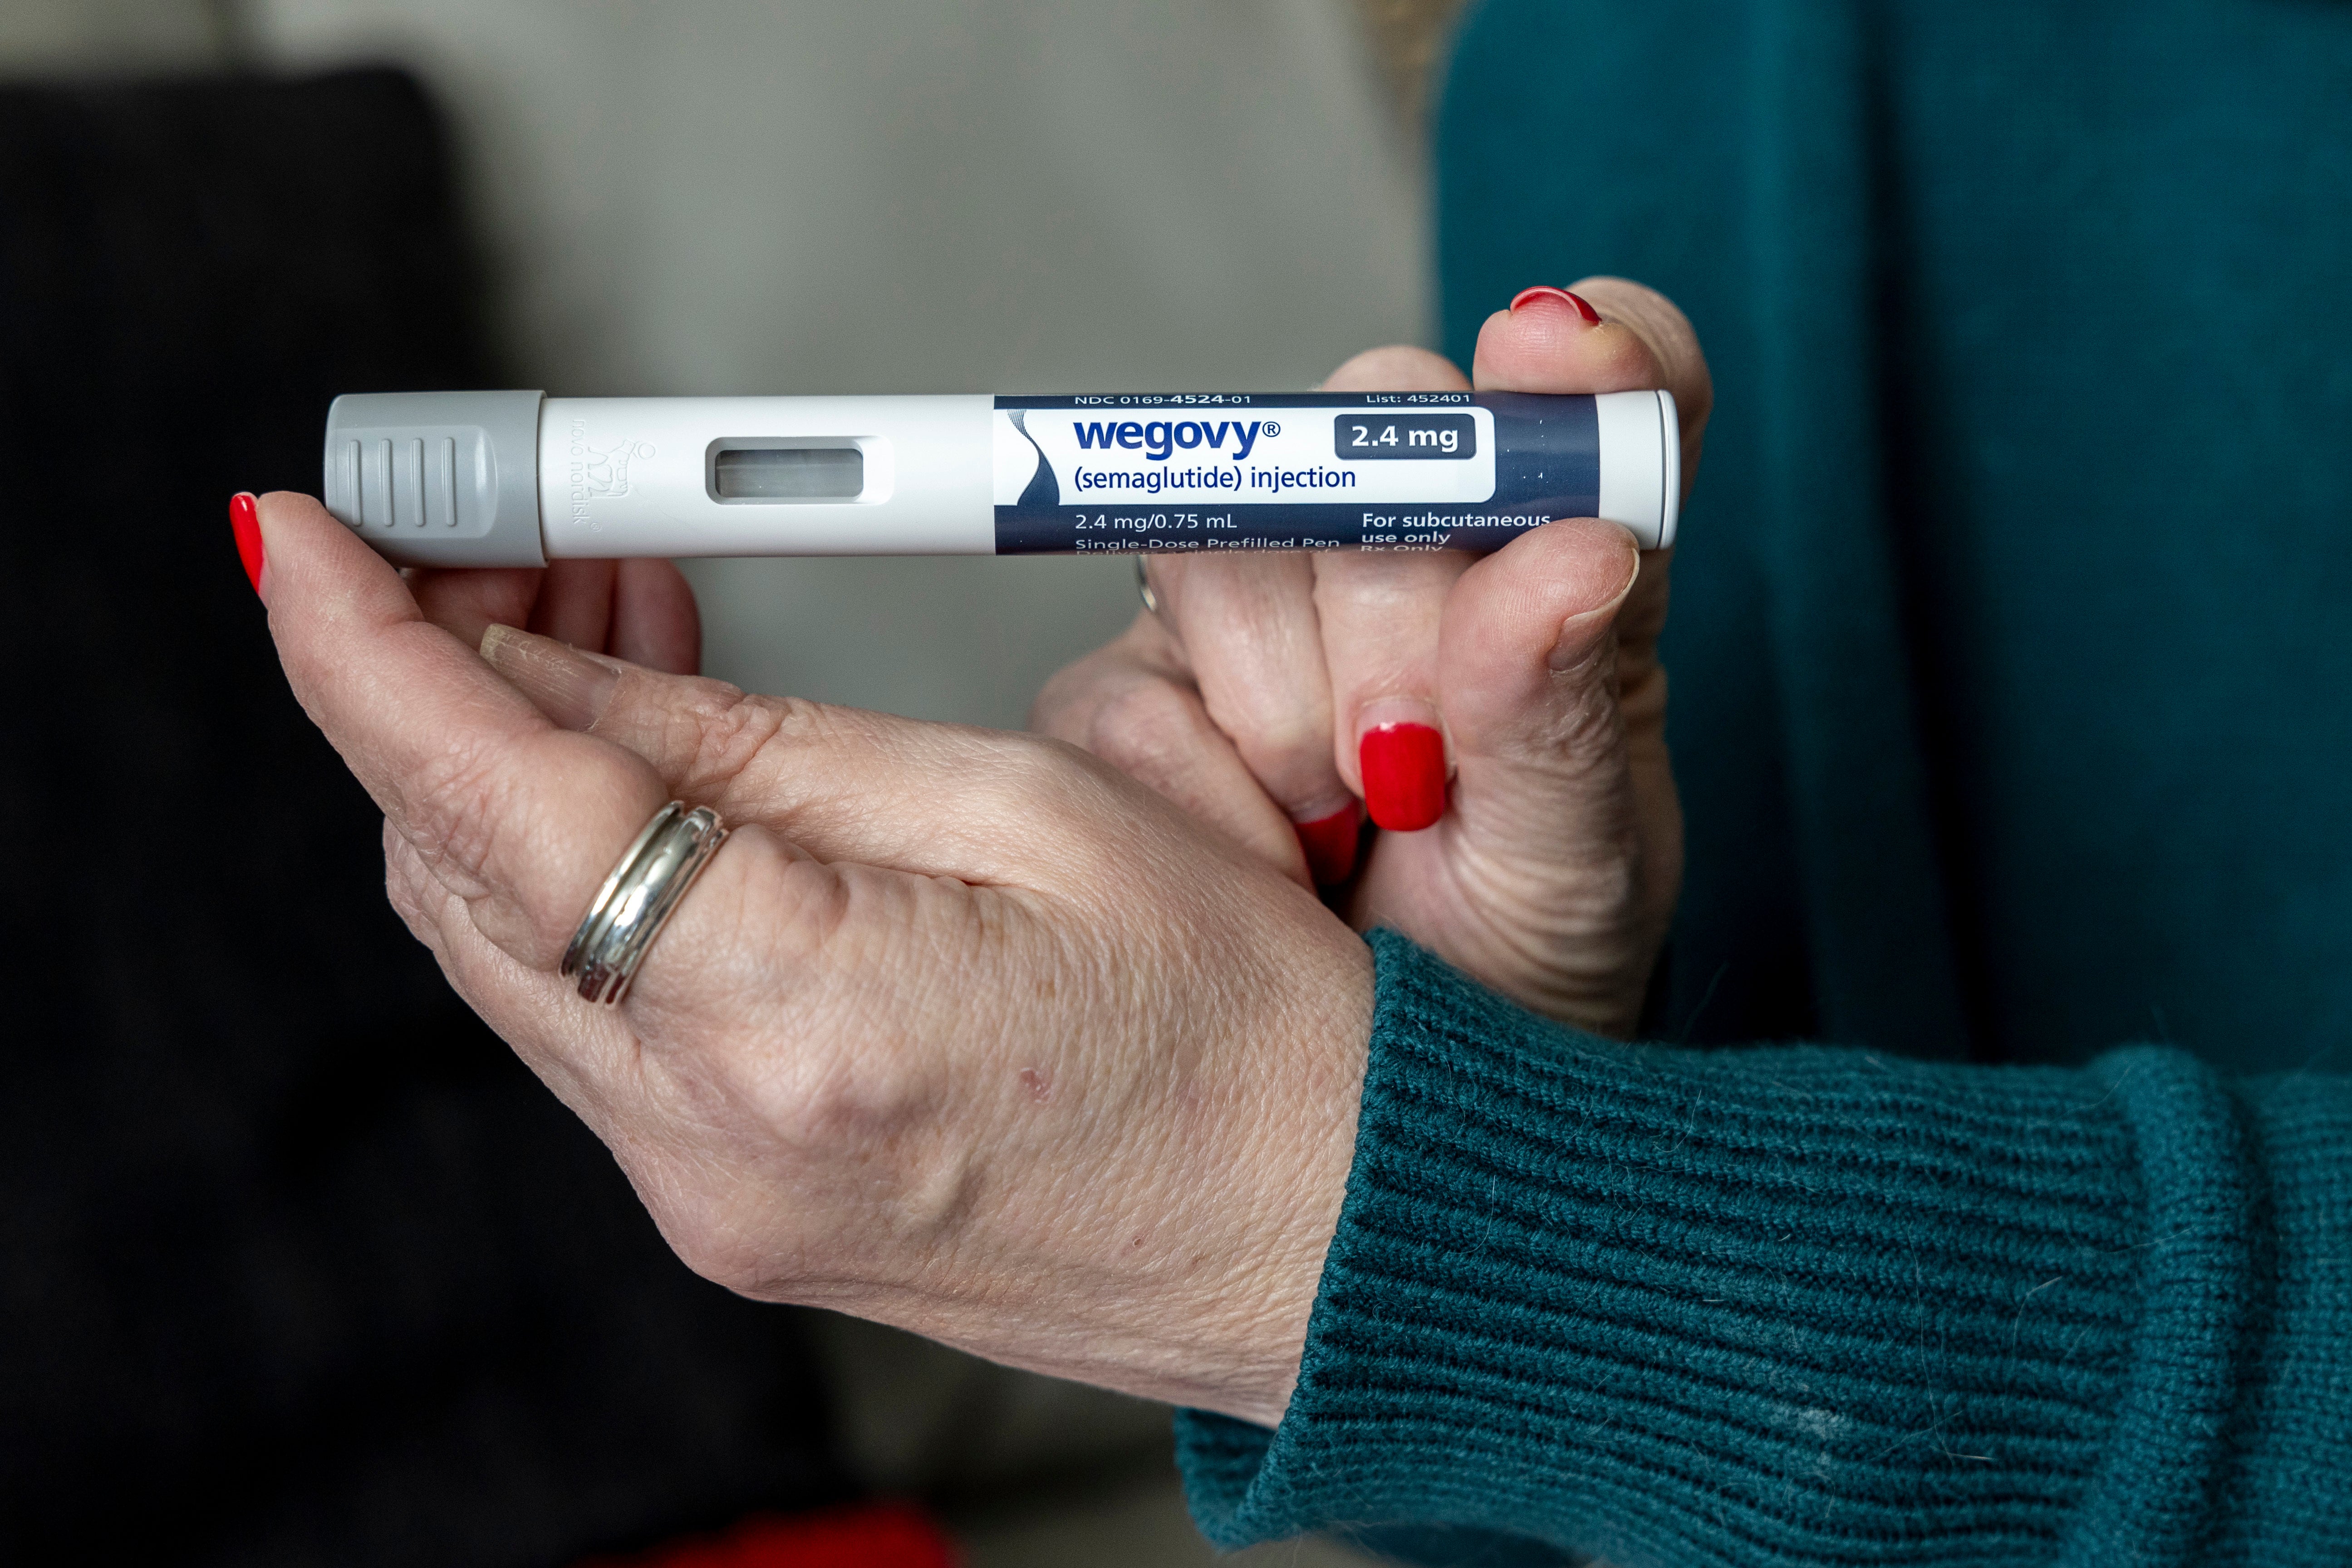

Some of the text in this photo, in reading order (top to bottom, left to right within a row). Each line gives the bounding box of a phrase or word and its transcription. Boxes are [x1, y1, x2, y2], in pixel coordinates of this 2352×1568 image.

[1120, 395, 1251, 404] 0169-4524-01
[1366, 394, 1470, 403] List: 452401
[571, 419, 585, 456] novo
[1352, 426, 1458, 452] 2.4 mg
[1075, 466, 1356, 494] (semaglutide) injection
[1075, 513, 1237, 532] 2.4 mg/0.75 mL
[1363, 512, 1551, 527] For subcutaneous
[1075, 538, 1340, 551] Single-Dose Prefilled Pen
[1362, 531, 1451, 545] use only
